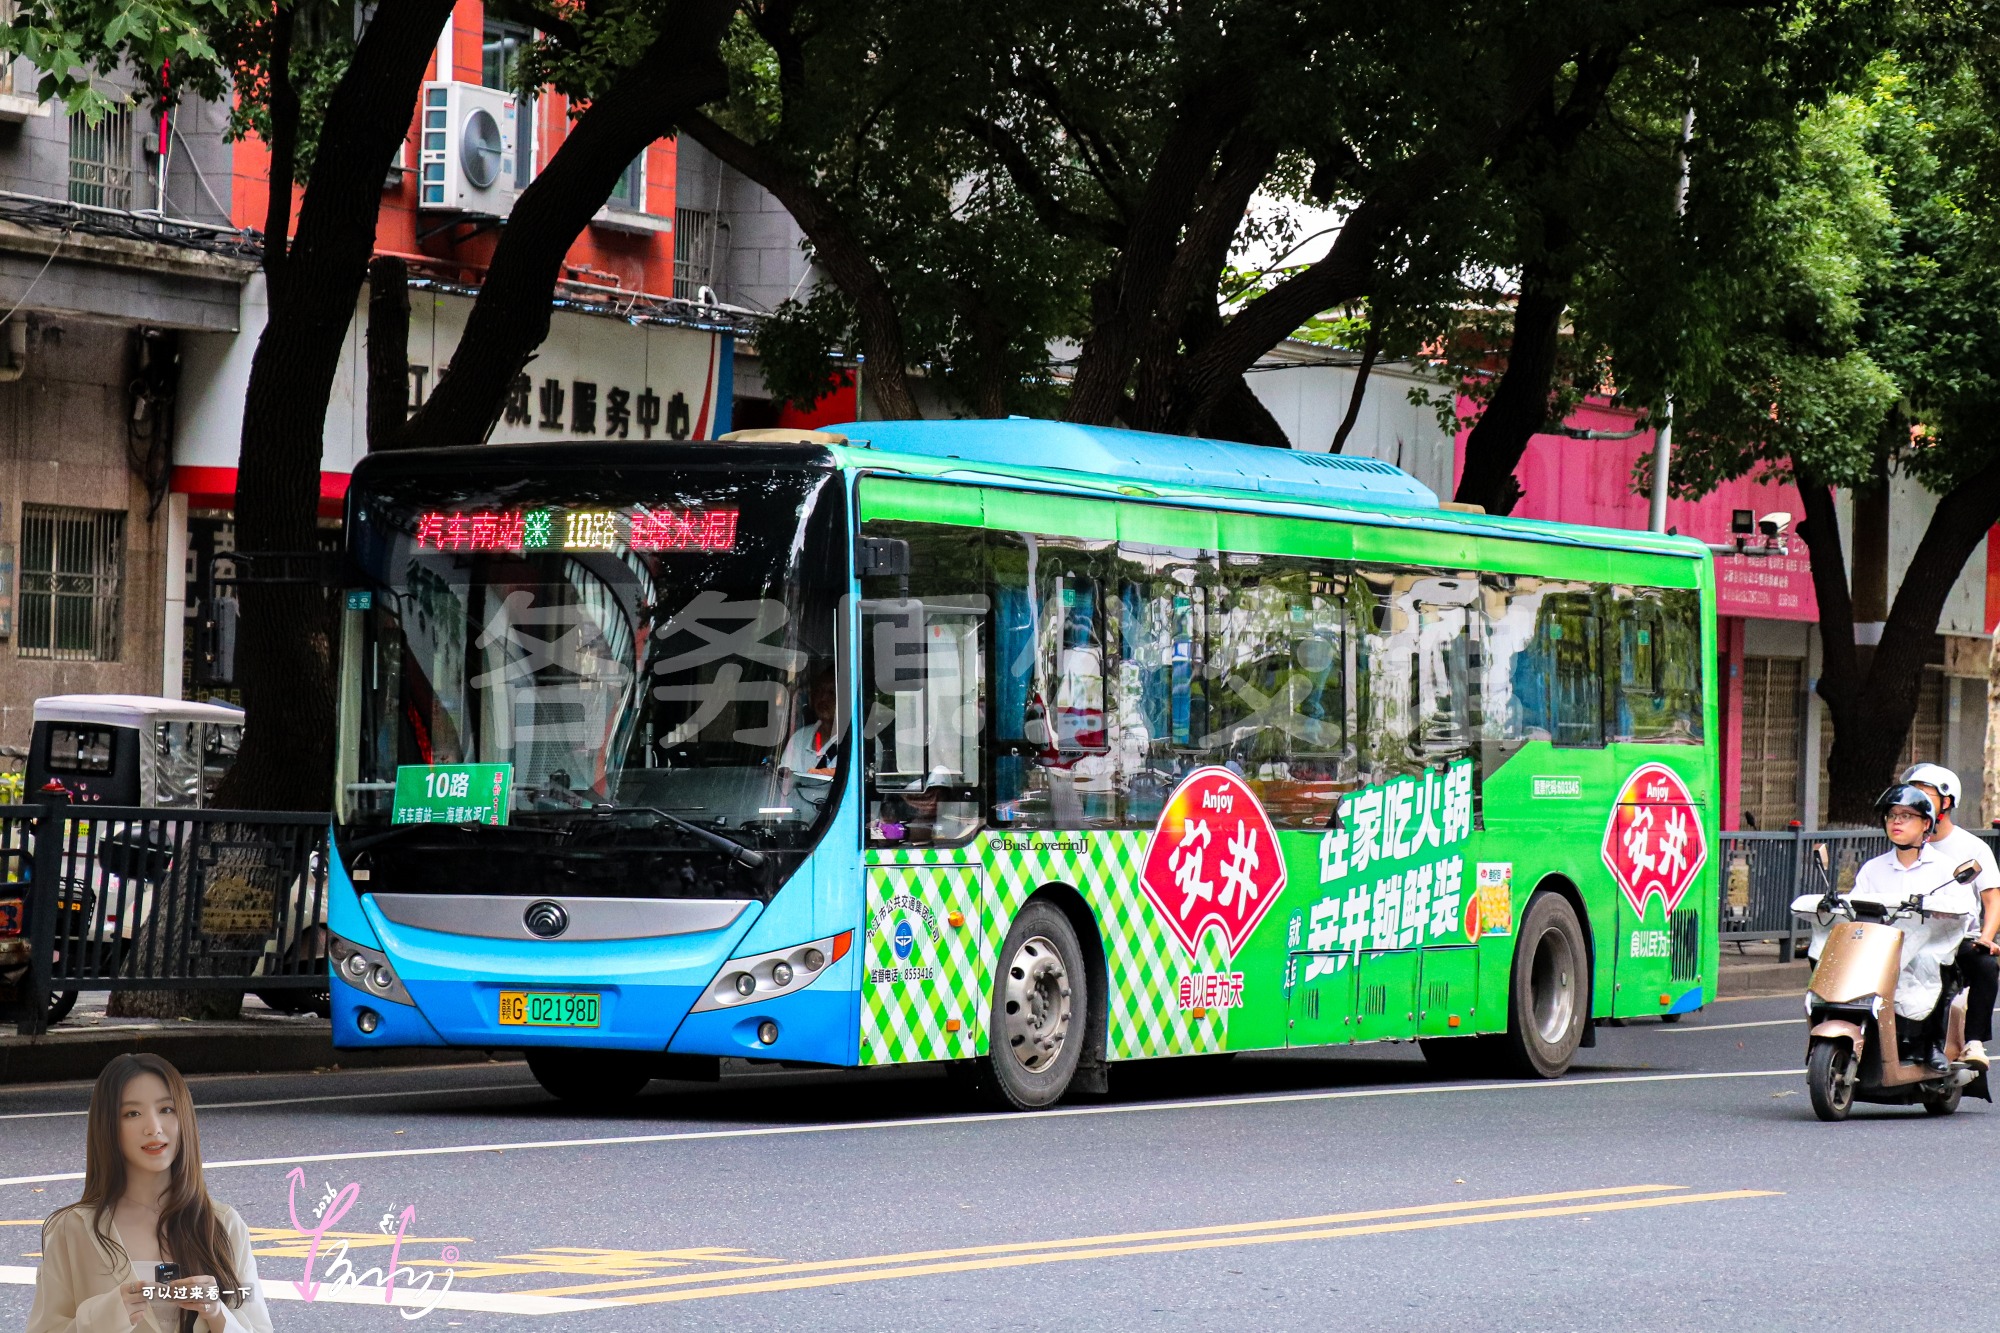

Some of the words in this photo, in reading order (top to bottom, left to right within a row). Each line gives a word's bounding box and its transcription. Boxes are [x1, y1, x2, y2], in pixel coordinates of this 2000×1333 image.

[417, 511, 525, 550] 汽车南站
[564, 512, 618, 549] 10路
[425, 772, 470, 798] 10路
[1202, 782, 1234, 814] Anjoy
[1646, 776, 1669, 802] Anjoy
[1319, 763, 1472, 884] 在家吃火锅
[1623, 806, 1687, 887] 安井
[1168, 818, 1259, 921] 安井
[866, 894, 940, 943] 九江市公共交通集团公司
[1305, 855, 1463, 982] 安井锁鲜装
[1179, 974, 1243, 1009] 食以民为天
